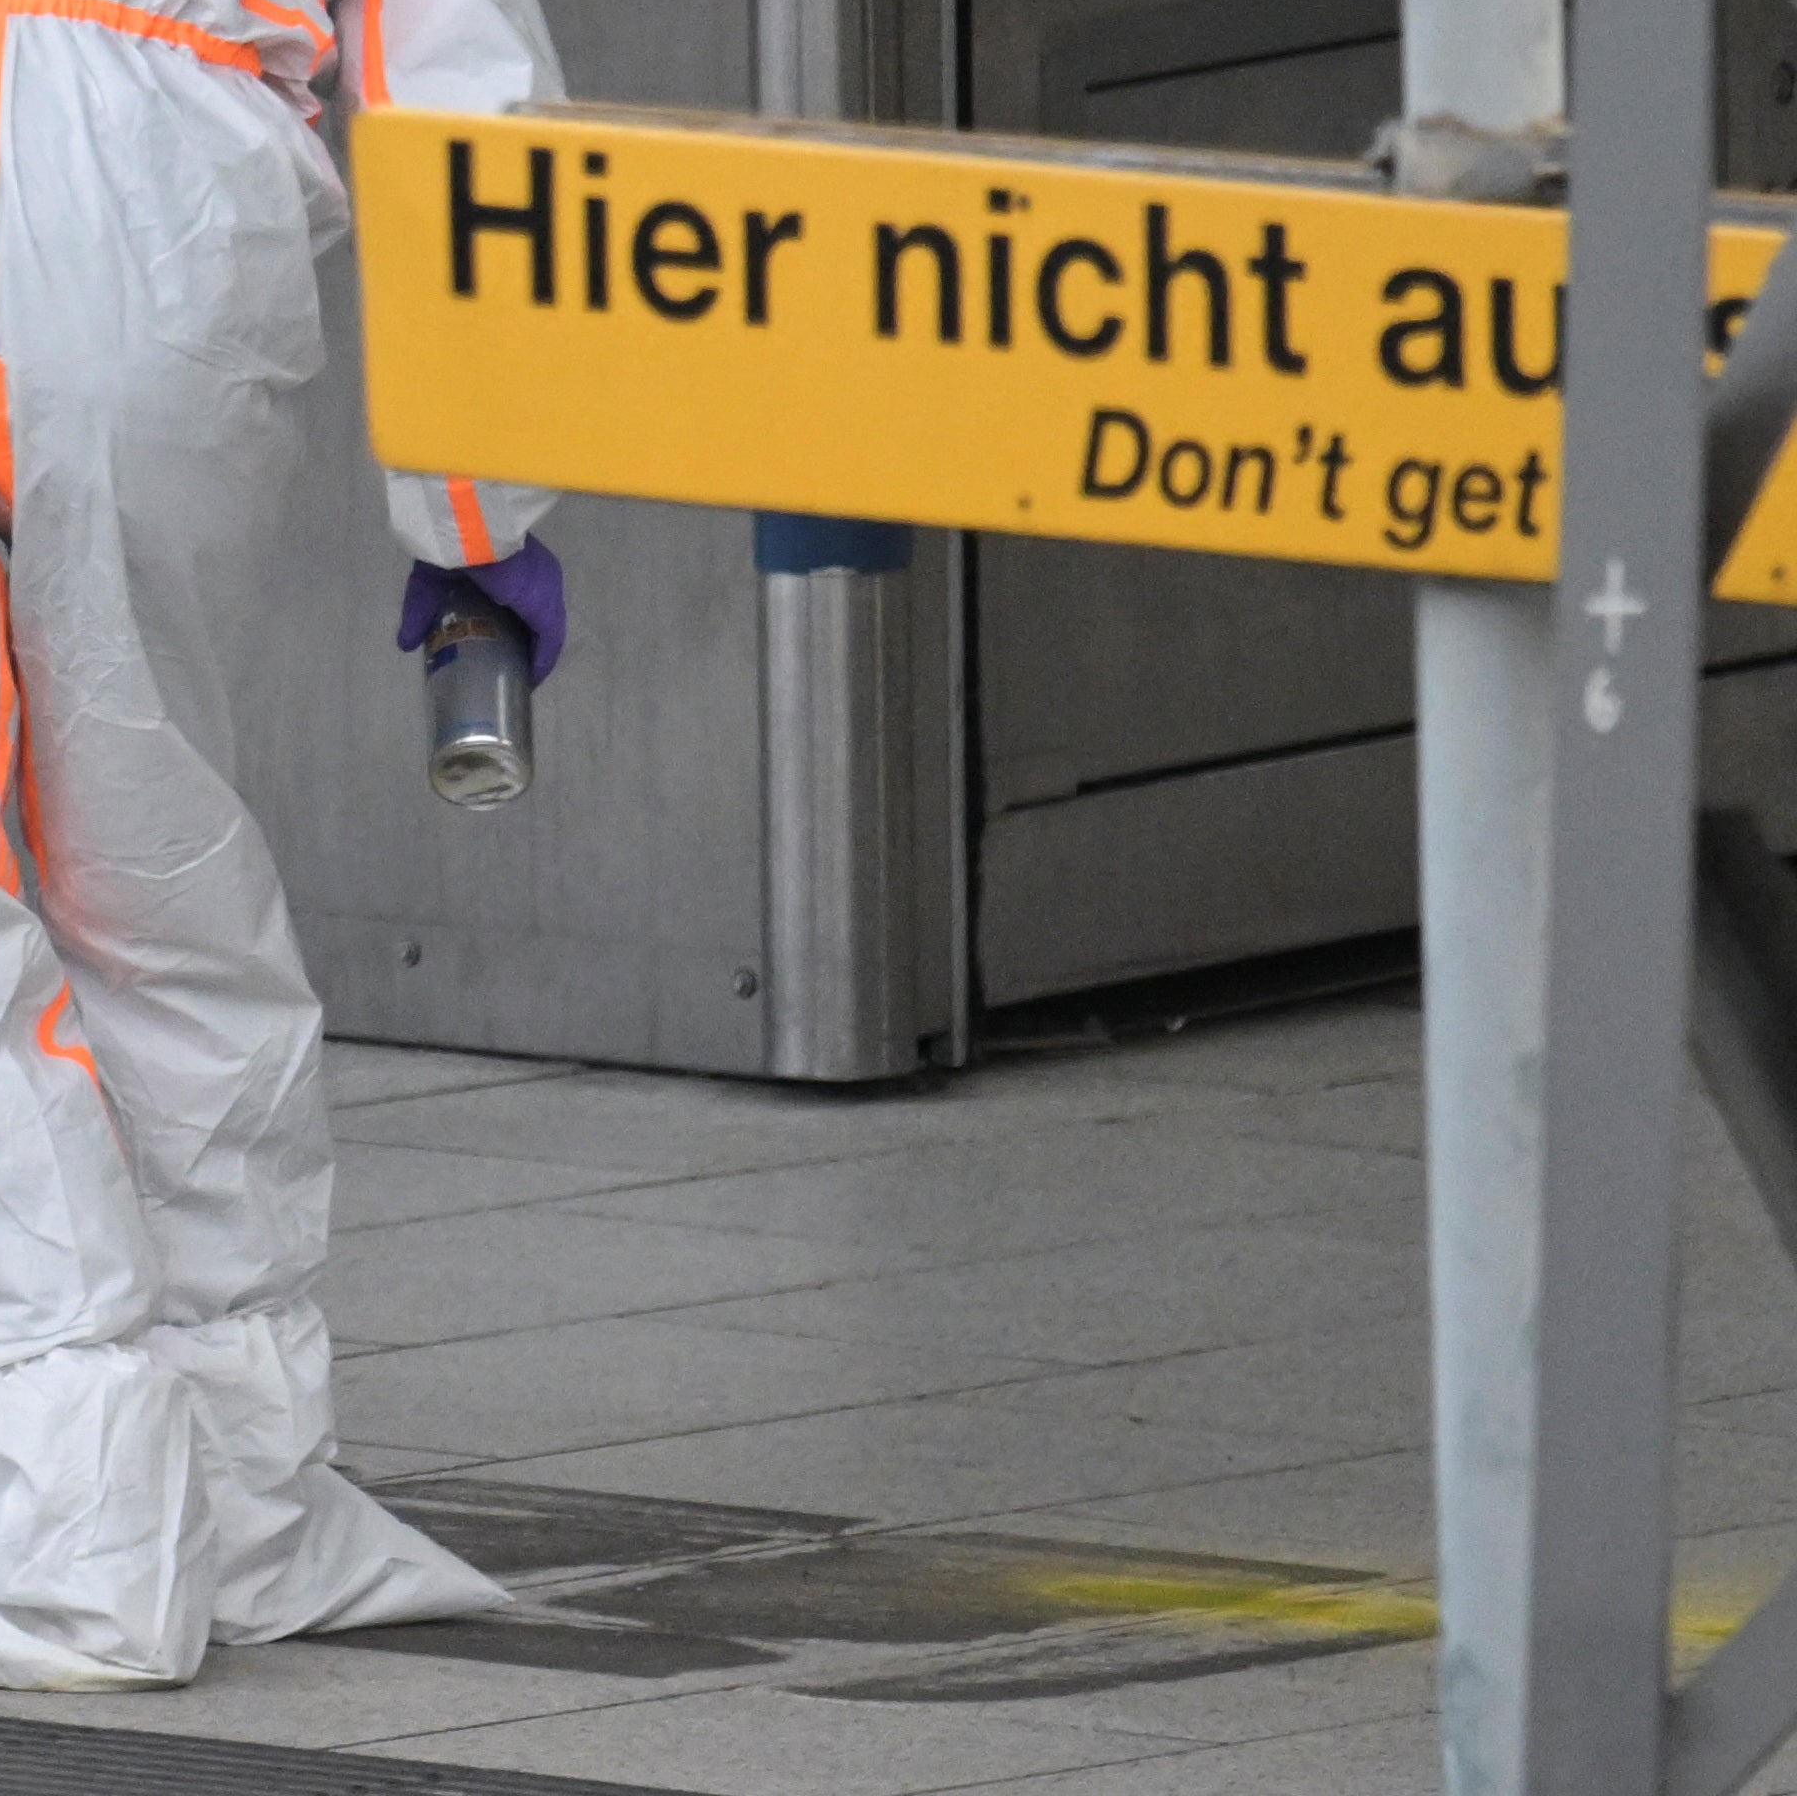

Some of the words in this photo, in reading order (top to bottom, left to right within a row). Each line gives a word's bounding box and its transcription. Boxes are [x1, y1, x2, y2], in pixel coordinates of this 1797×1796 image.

[447, 138, 804, 326] Hier
[873, 188, 1307, 376] nicht
[1080, 406, 1353, 521] Don't
[1382, 450, 1549, 551] get
